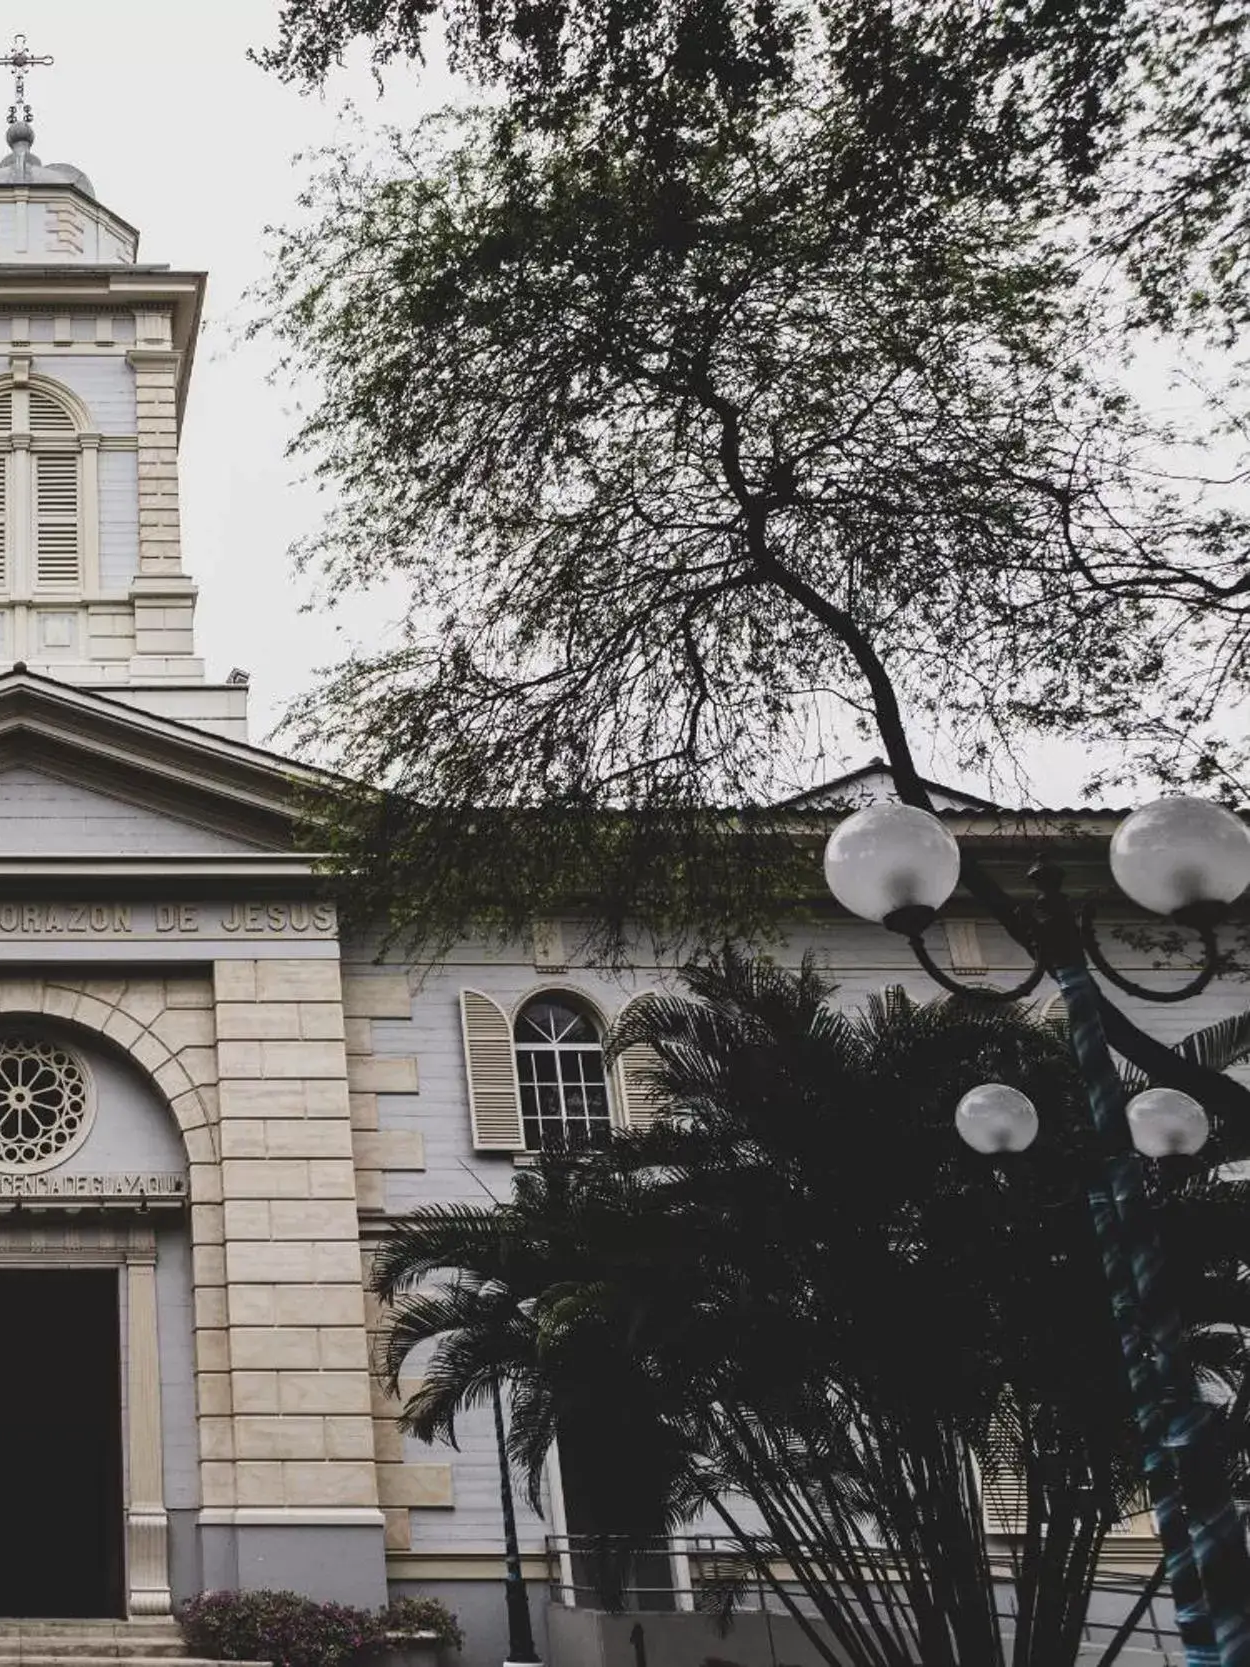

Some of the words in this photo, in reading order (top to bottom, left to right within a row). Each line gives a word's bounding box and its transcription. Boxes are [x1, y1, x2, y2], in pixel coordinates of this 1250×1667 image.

[155, 902, 199, 932] DE
[221, 902, 336, 932] JESUS
[65, 1175, 88, 1193] DE
